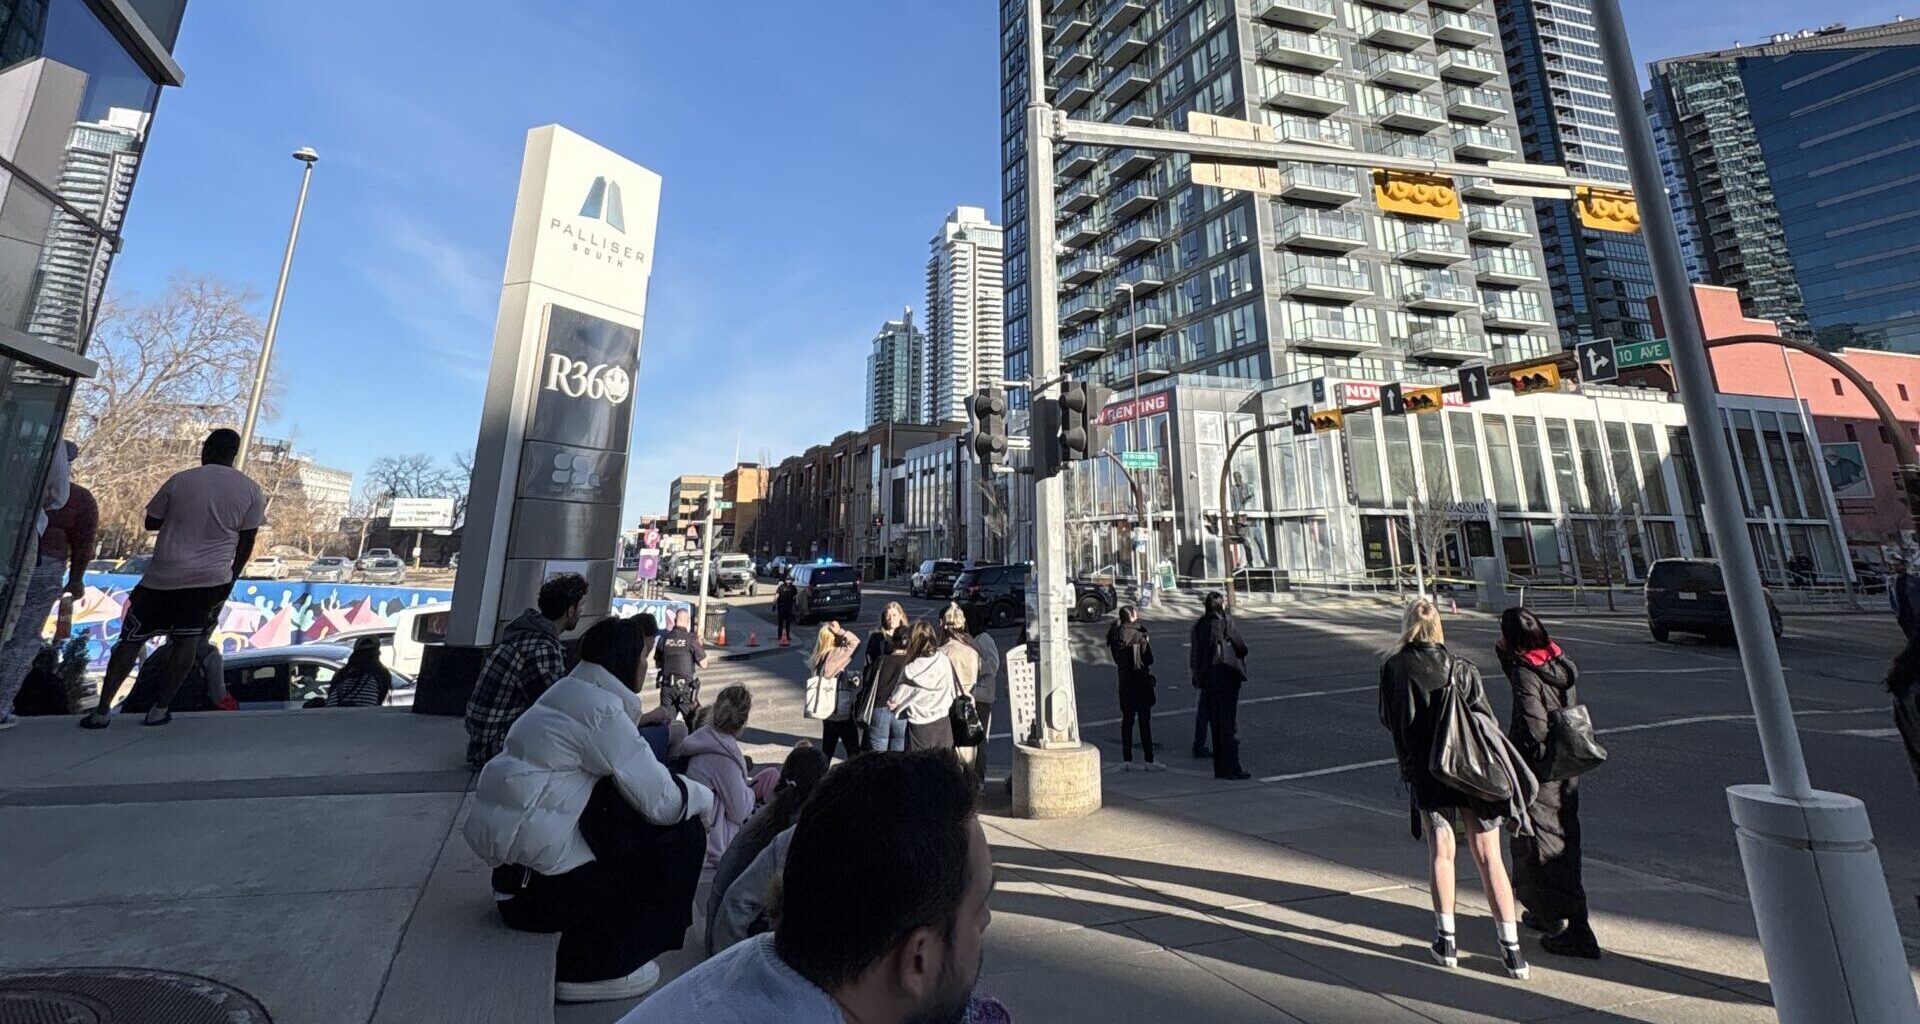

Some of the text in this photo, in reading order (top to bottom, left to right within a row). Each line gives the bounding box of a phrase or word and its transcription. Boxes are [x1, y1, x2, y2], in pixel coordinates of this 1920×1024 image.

[549, 217, 646, 264] PALLISER
[571, 242, 625, 268] SOUTH
[1618, 344, 1663, 363] 10 AVE
[665, 638, 687, 648] POLICE
